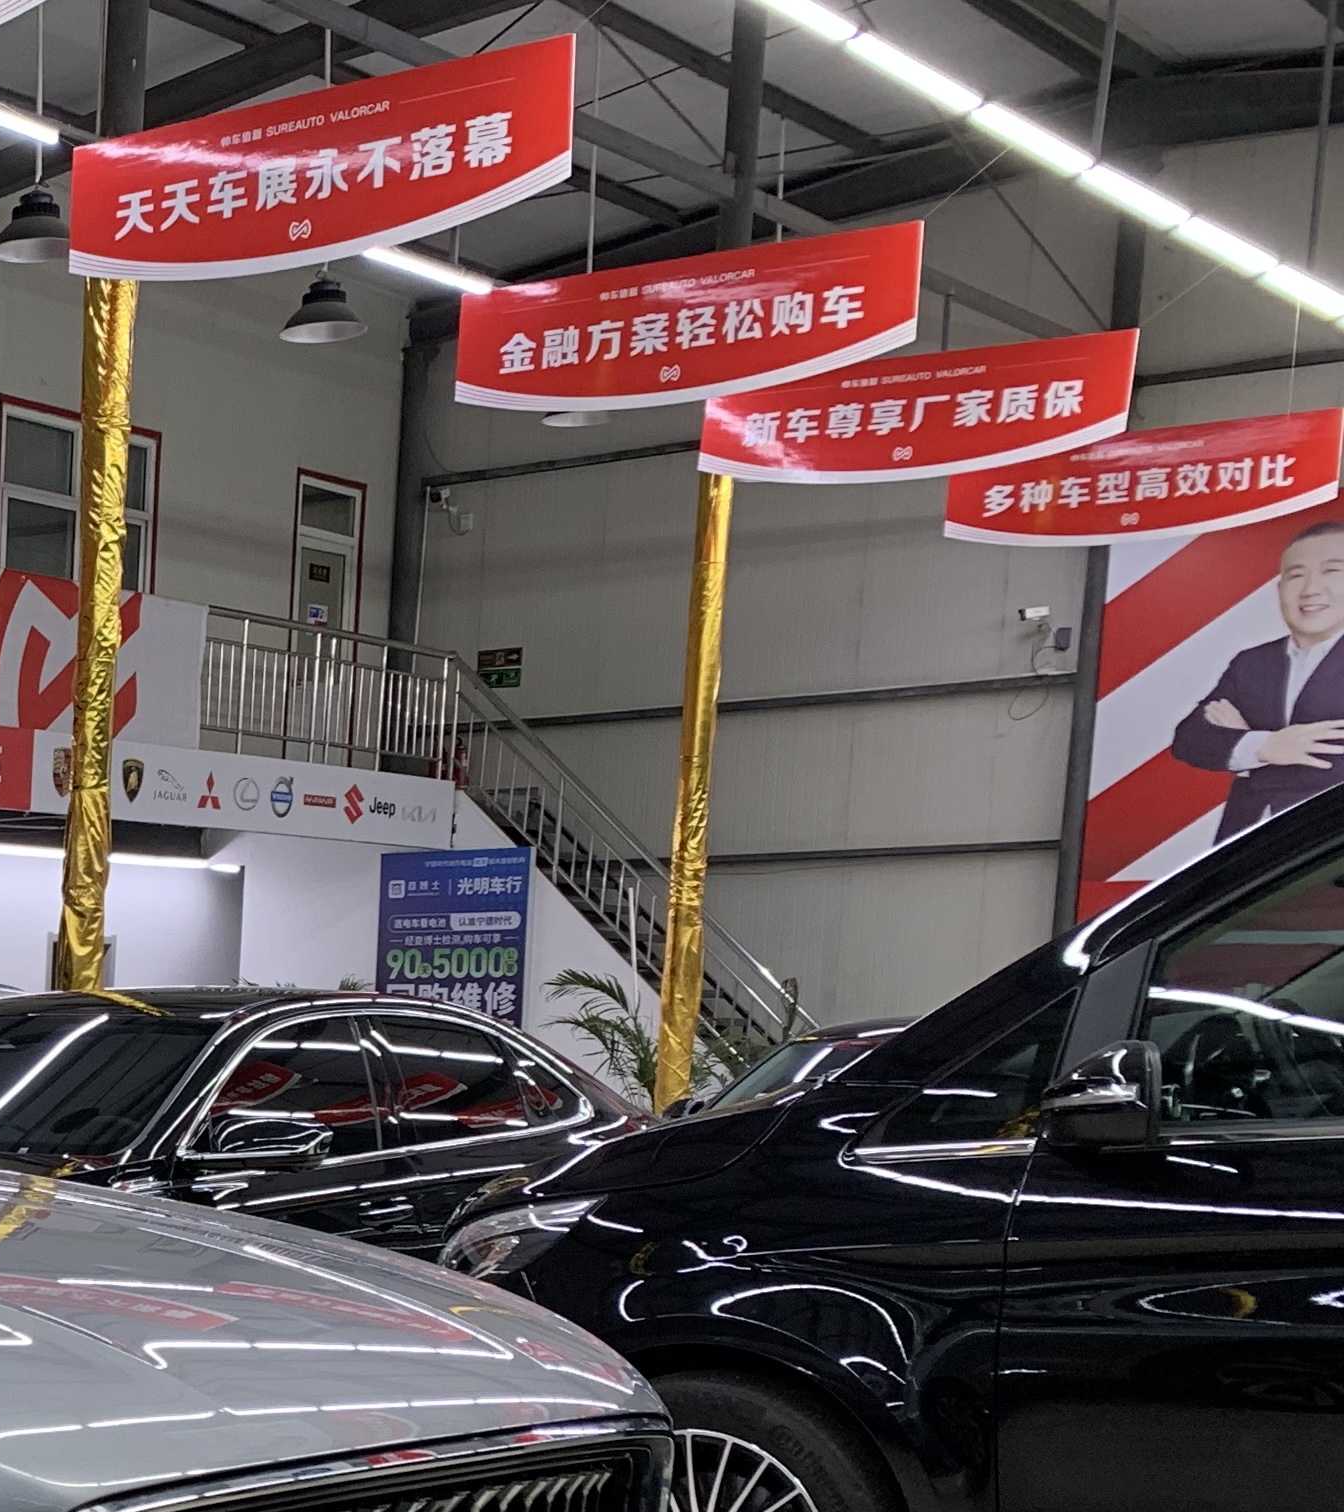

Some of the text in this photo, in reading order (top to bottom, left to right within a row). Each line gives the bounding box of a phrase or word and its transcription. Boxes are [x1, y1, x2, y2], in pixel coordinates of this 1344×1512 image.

[266, 114, 325, 137] SUREAUTO
[330, 100, 390, 123] VALORCAR
[114, 111, 513, 241] 天天车展永不落幕
[700, 268, 756, 285] VALORCAR
[499, 285, 865, 375] 金融方案轻松购车
[881, 371, 932, 385] SUREAUTO
[936, 365, 987, 378] VALORCAR
[743, 379, 1085, 448] 新车尊享厂家质保
[982, 454, 1296, 518] 多种车型高效对比
[153, 790, 187, 802] JAGUAR
[369, 796, 396, 819] Jeep
[457, 875, 523, 896] 光明车行
